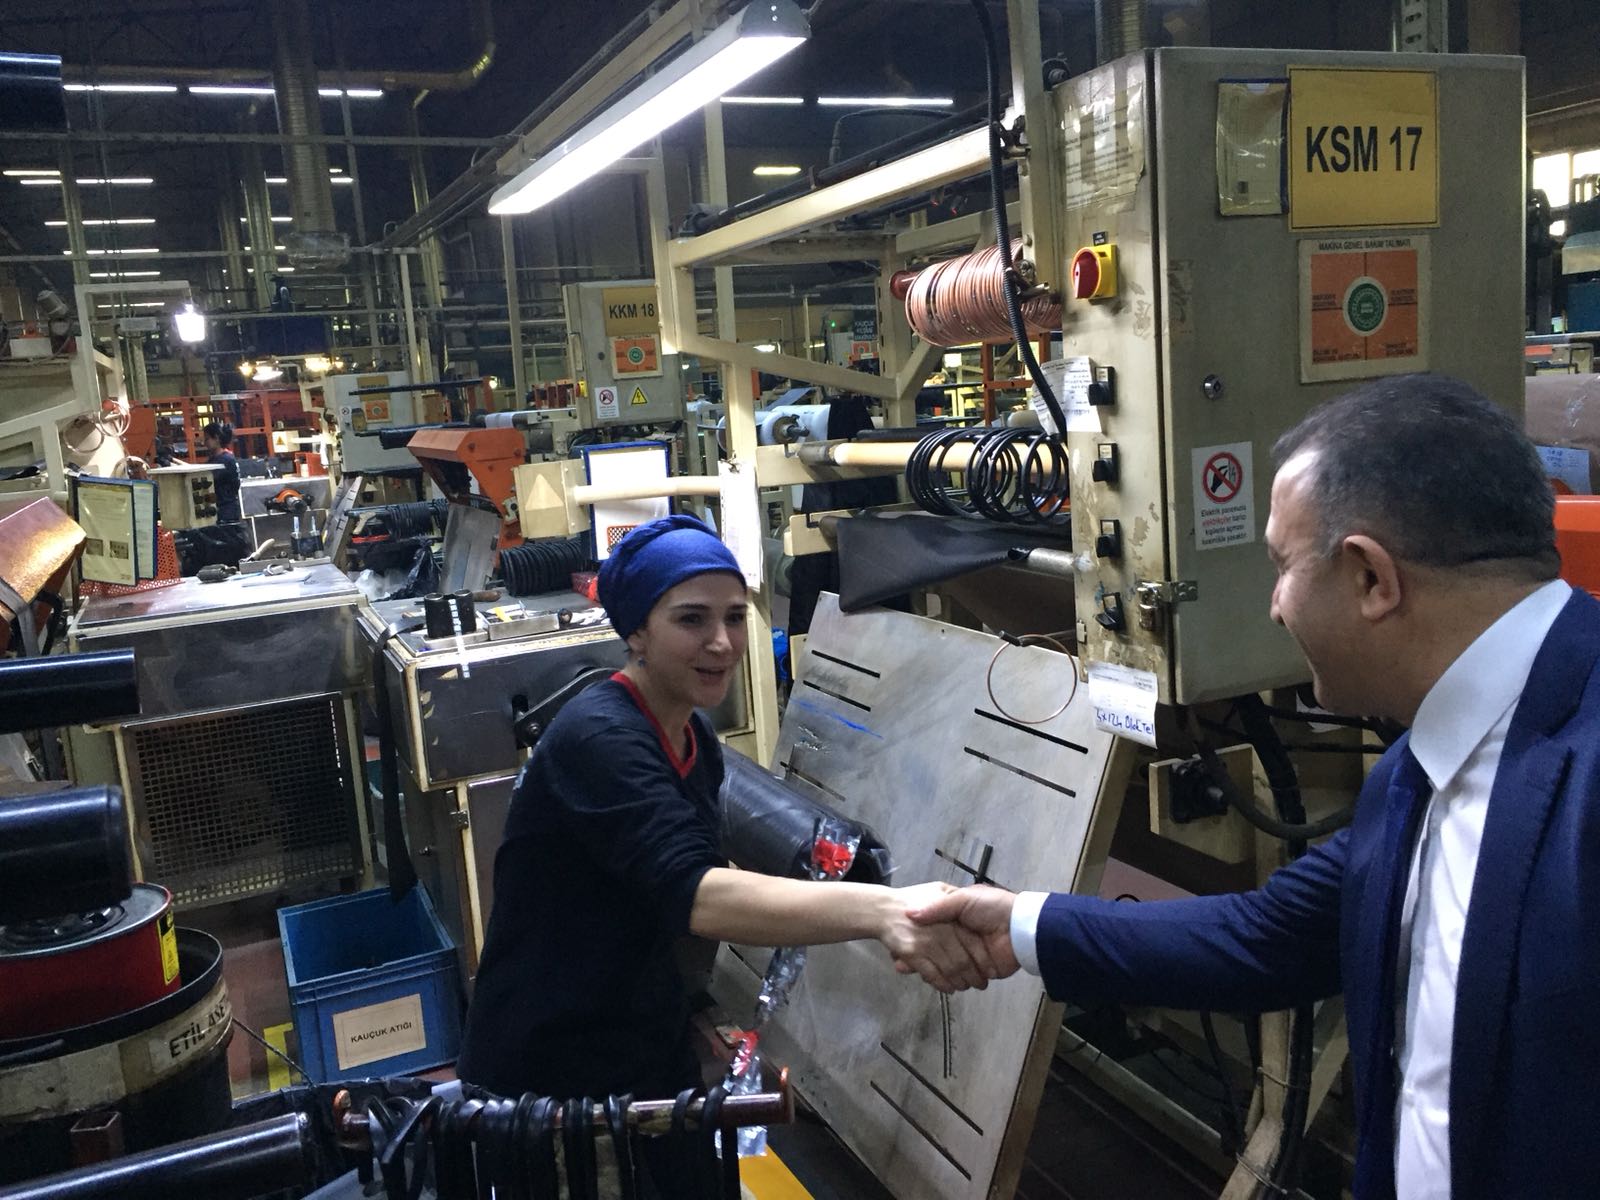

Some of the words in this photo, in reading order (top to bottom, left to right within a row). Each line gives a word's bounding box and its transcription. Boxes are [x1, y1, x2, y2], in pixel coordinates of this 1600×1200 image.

[1305, 125, 1378, 173] KSM
[1389, 125, 1423, 172] 17
[609, 304, 638, 319] KKM
[641, 303, 655, 317] 18
[350, 1028, 388, 1043] KAUÇUK
[389, 1021, 412, 1033] ATIĞI
